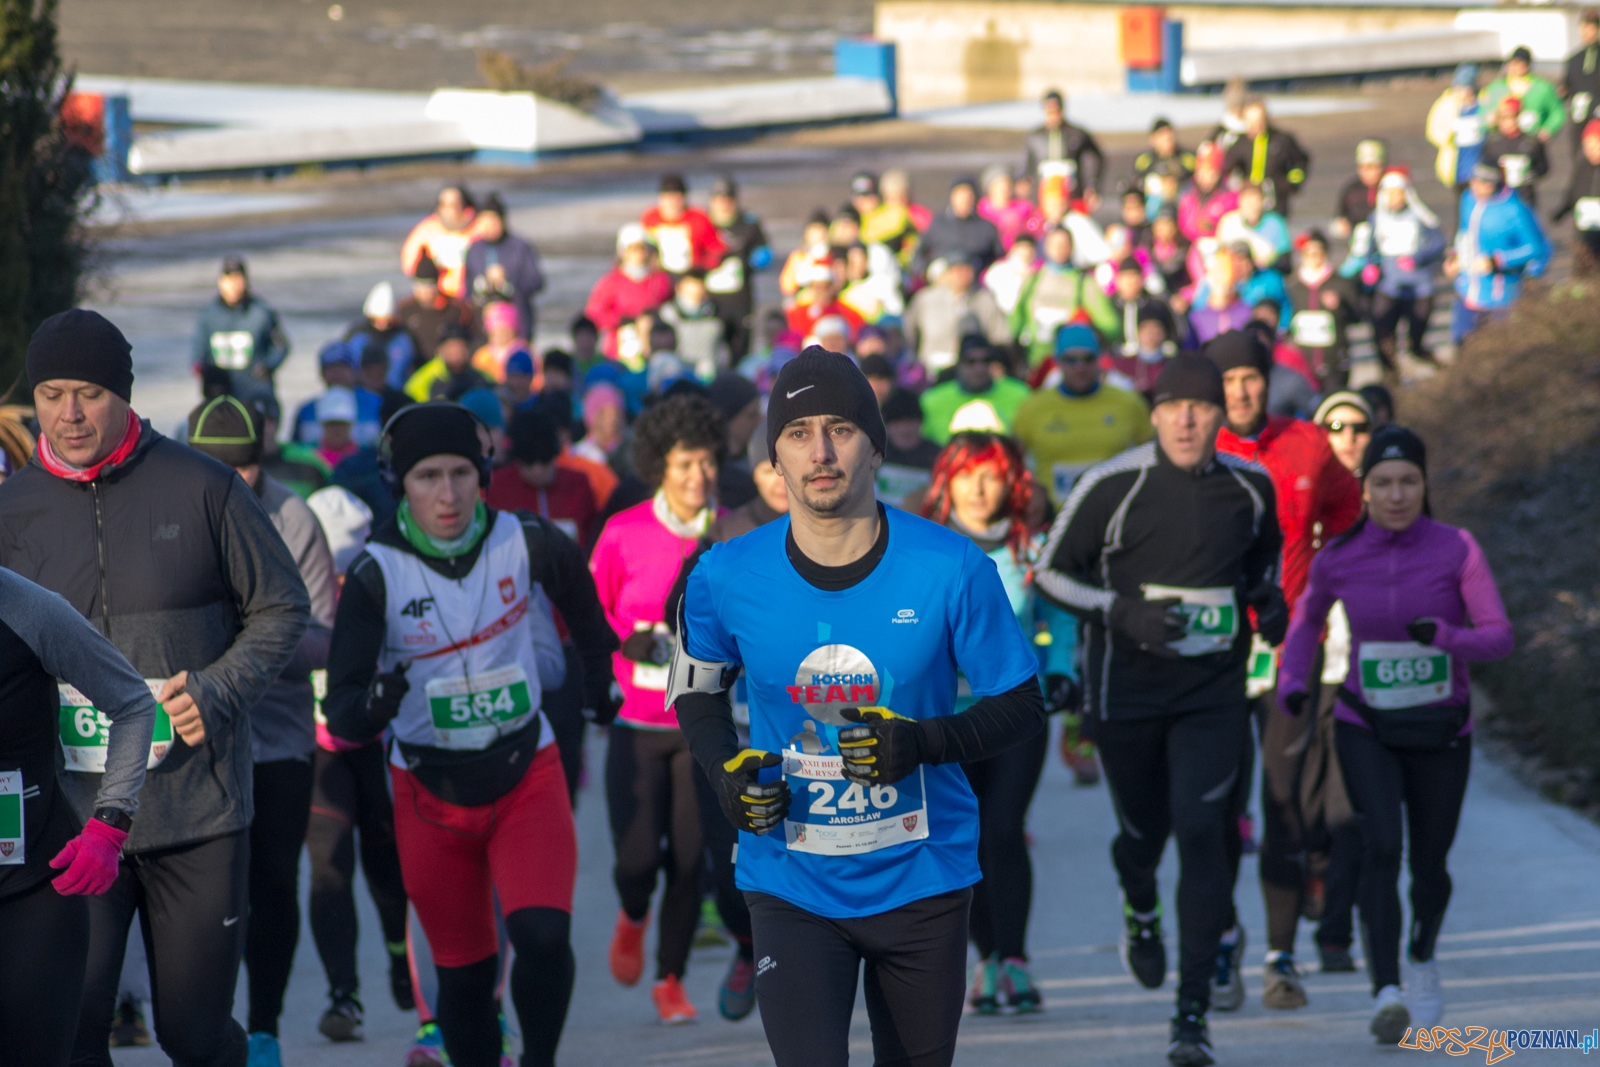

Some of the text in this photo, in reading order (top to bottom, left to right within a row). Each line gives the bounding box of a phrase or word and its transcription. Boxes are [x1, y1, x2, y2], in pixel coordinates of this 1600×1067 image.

[1376, 657, 1434, 684] 669
[450, 686, 515, 722] 564
[786, 684, 875, 704] TEAM
[807, 781, 898, 815] 246
[828, 811, 881, 825] JAROSŁAW
